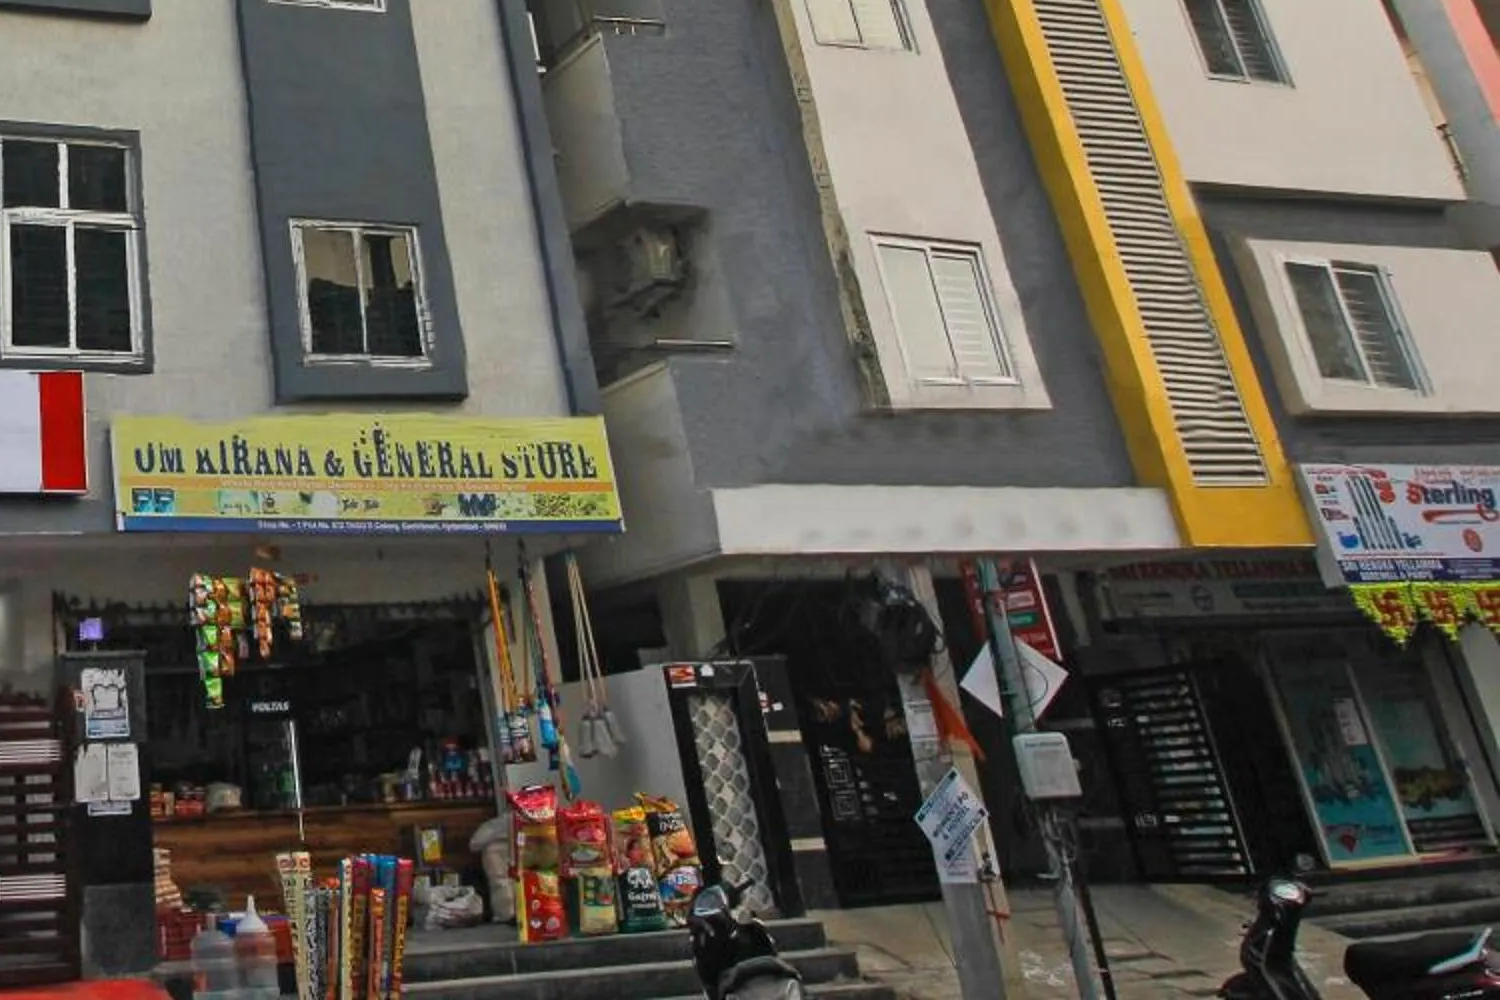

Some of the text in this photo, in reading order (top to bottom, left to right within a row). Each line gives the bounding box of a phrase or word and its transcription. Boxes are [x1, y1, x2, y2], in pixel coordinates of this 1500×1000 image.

[323, 449, 345, 478] &
[352, 427, 493, 479] GENERAL
[1406, 479, 1498, 510] Sterling
